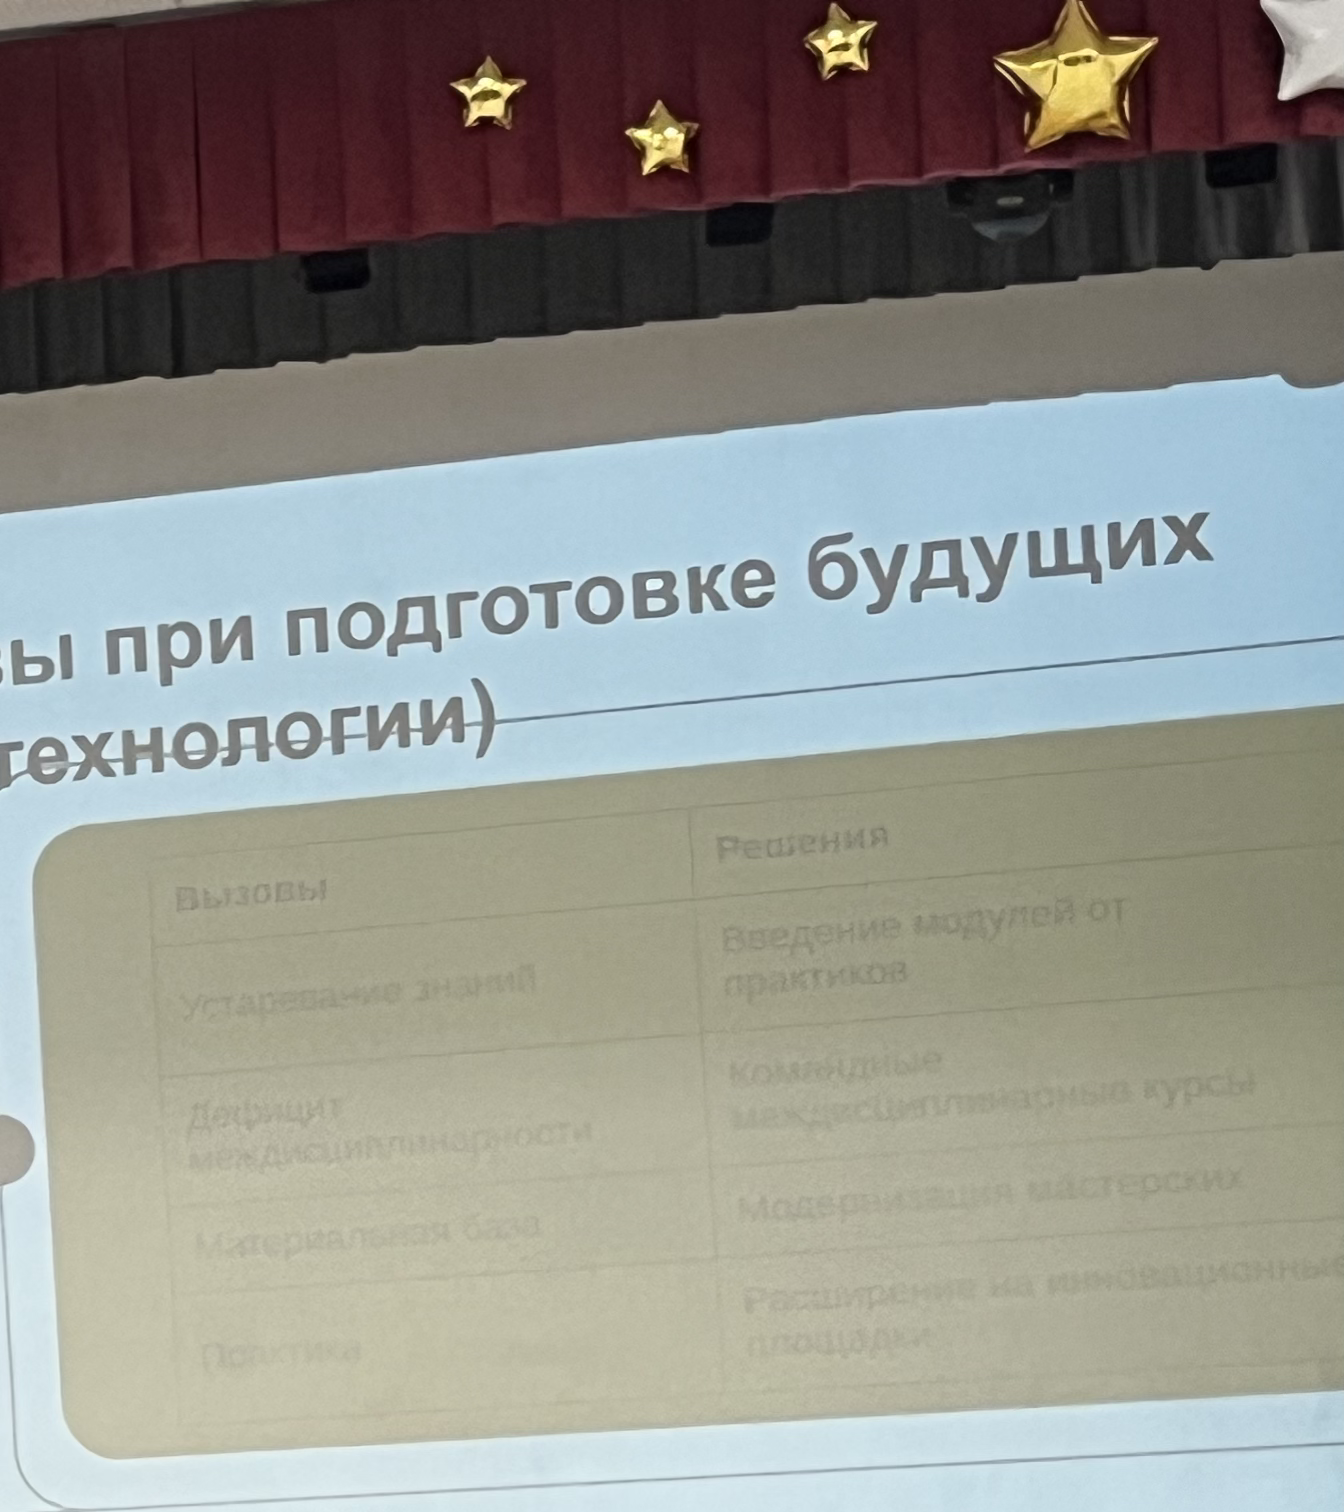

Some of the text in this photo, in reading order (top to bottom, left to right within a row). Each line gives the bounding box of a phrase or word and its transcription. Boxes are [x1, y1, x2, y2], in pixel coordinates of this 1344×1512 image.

[105, 615, 254, 687] при
[286, 556, 777, 657] подготовке
[807, 511, 1215, 615] будущих
[715, 823, 890, 863] Решения
[174, 878, 329, 913] Вызовы
[721, 913, 902, 957] Введение
